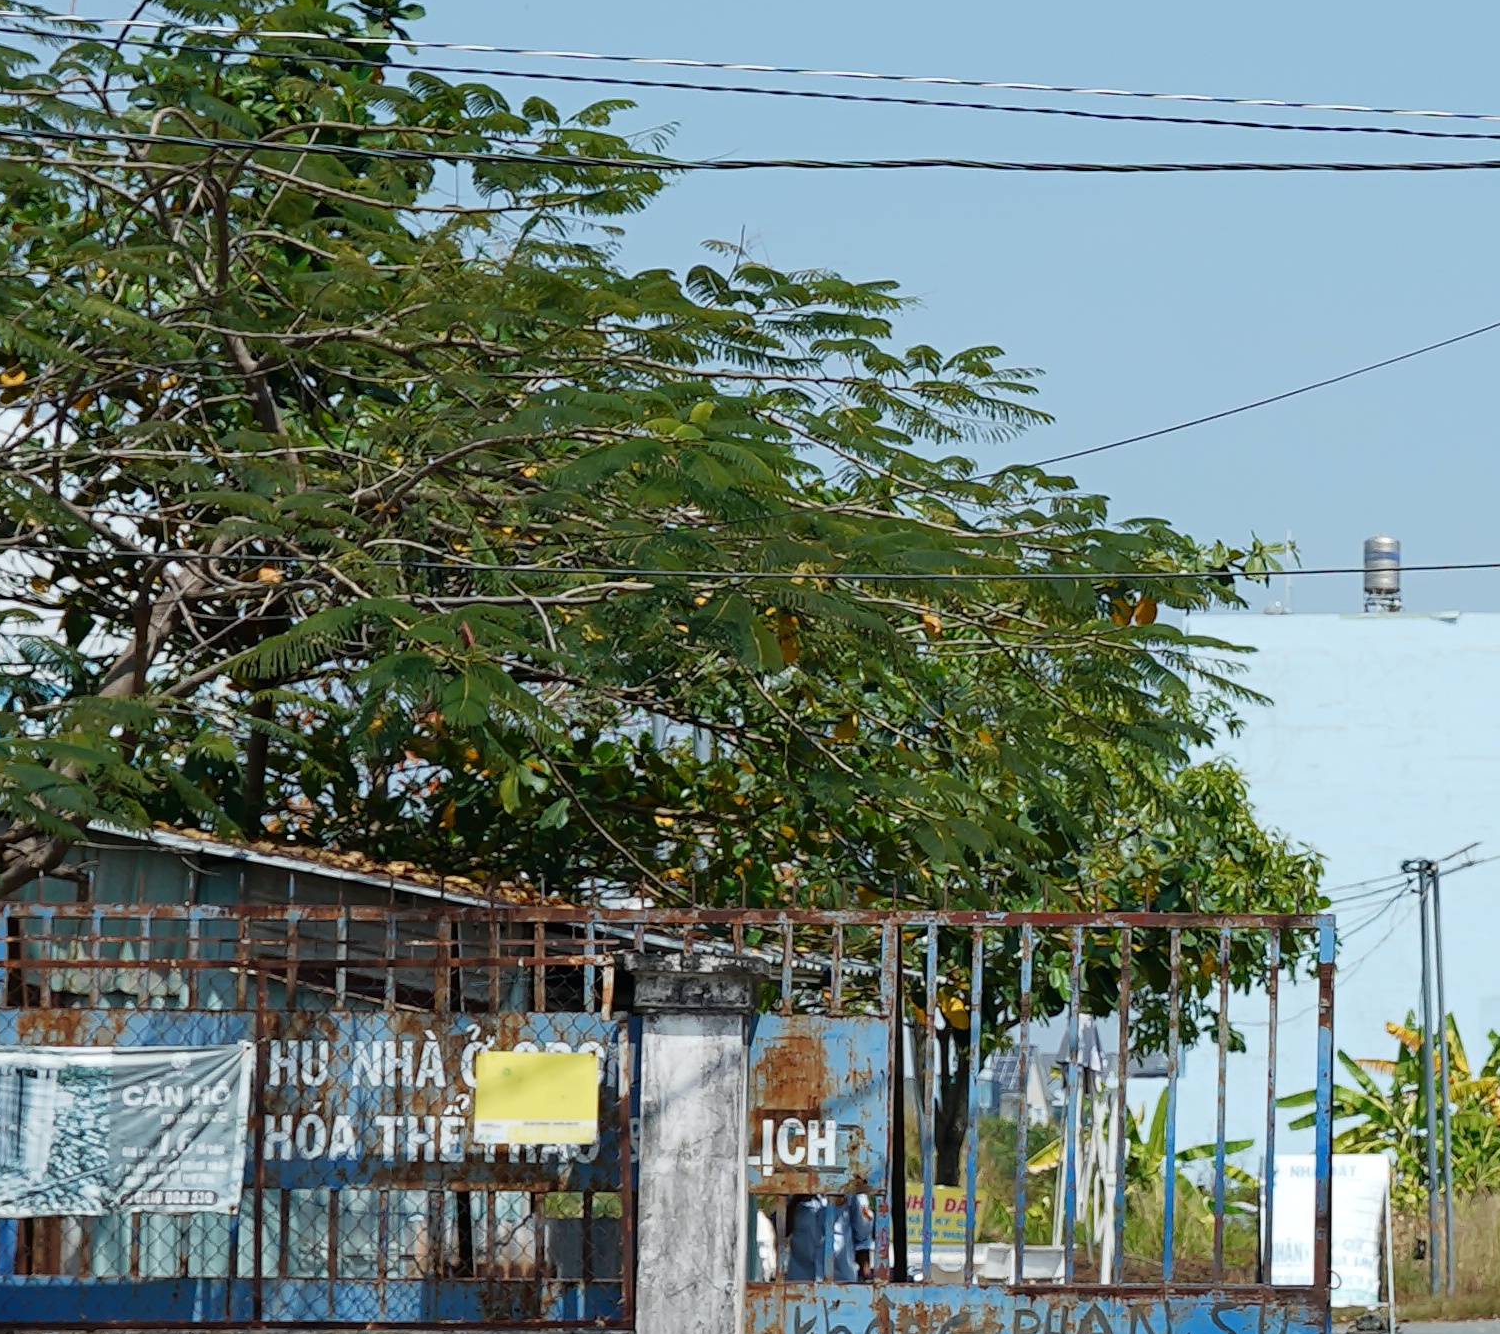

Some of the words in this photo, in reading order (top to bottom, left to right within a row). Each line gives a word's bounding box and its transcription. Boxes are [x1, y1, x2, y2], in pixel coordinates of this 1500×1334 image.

[269, 1040, 330, 1087] HU
[352, 1029, 446, 1089] NHÀ
[122, 1080, 184, 1107] CĂN
[263, 1101, 358, 1161] HÓA
